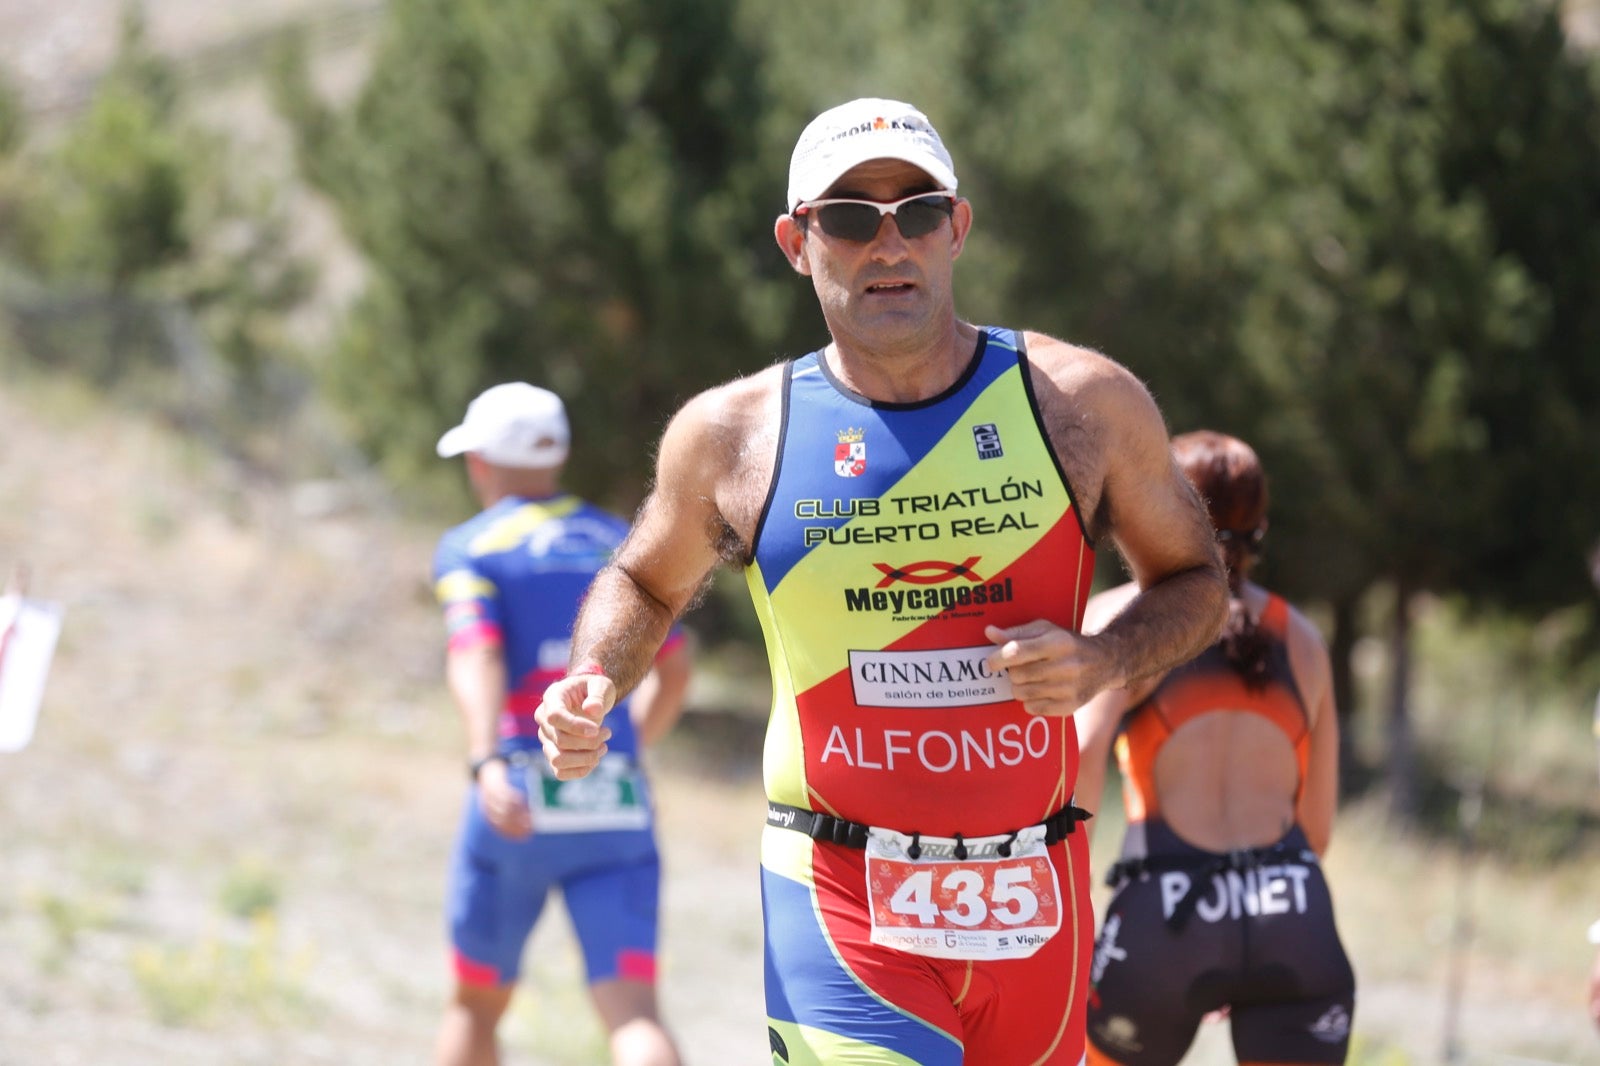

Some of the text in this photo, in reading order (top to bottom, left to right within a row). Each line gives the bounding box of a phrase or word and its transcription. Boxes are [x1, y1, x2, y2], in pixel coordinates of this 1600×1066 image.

[796, 476, 1043, 518] CLUB TRIATLÓN
[805, 511, 1039, 546] PUERTO REAL
[844, 578, 1013, 614] Meycagesal
[884, 685, 996, 699] salón de belleza
[820, 716, 1050, 773] ALFONSO
[889, 866, 1039, 927] 435
